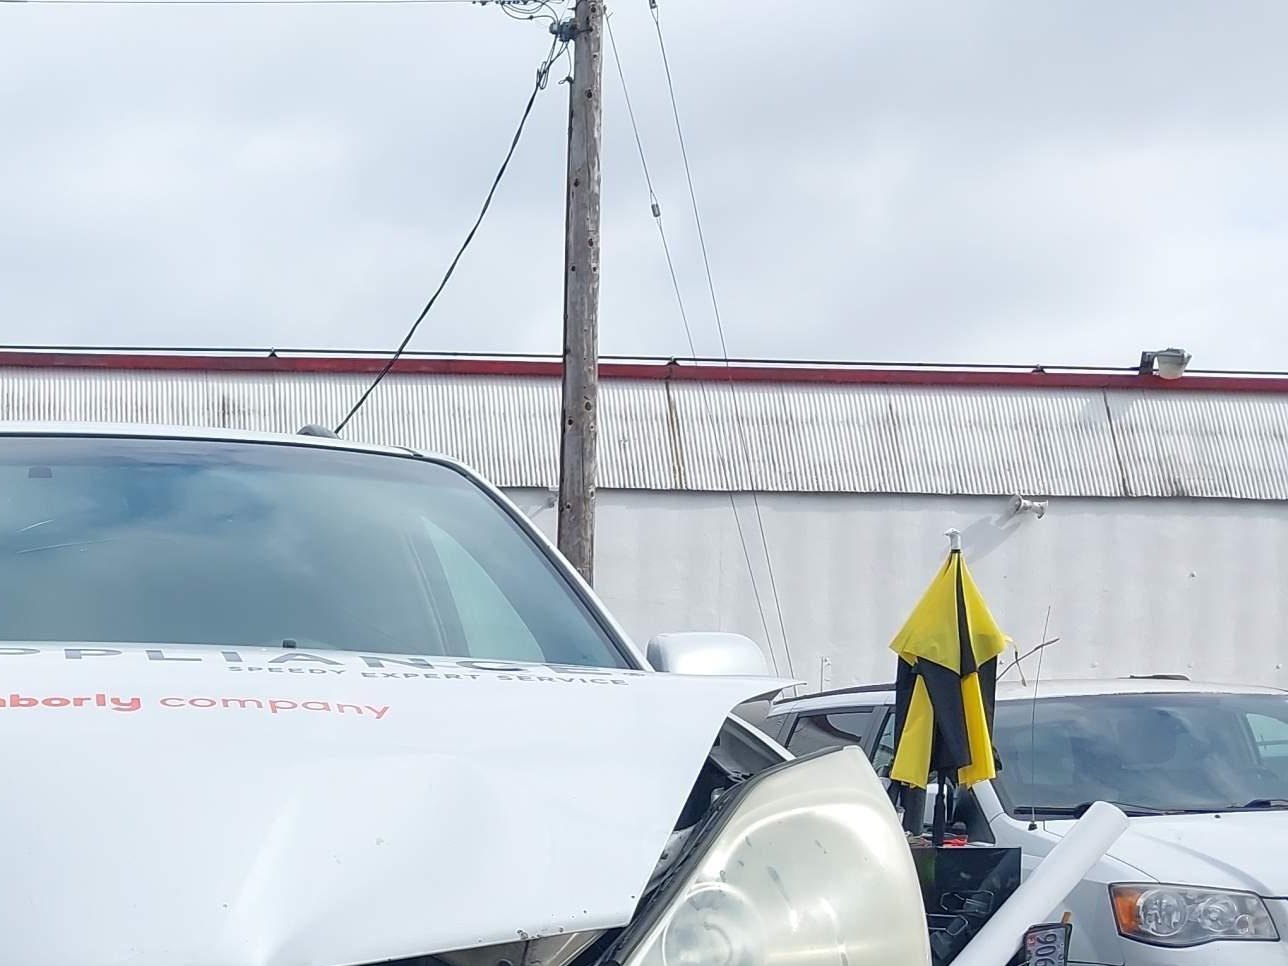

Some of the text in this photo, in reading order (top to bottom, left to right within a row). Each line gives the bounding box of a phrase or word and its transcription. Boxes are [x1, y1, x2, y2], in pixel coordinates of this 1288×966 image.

[228, 665, 630, 686] SPEEDY EXPERT SERVICE
[159, 696, 391, 720] company
